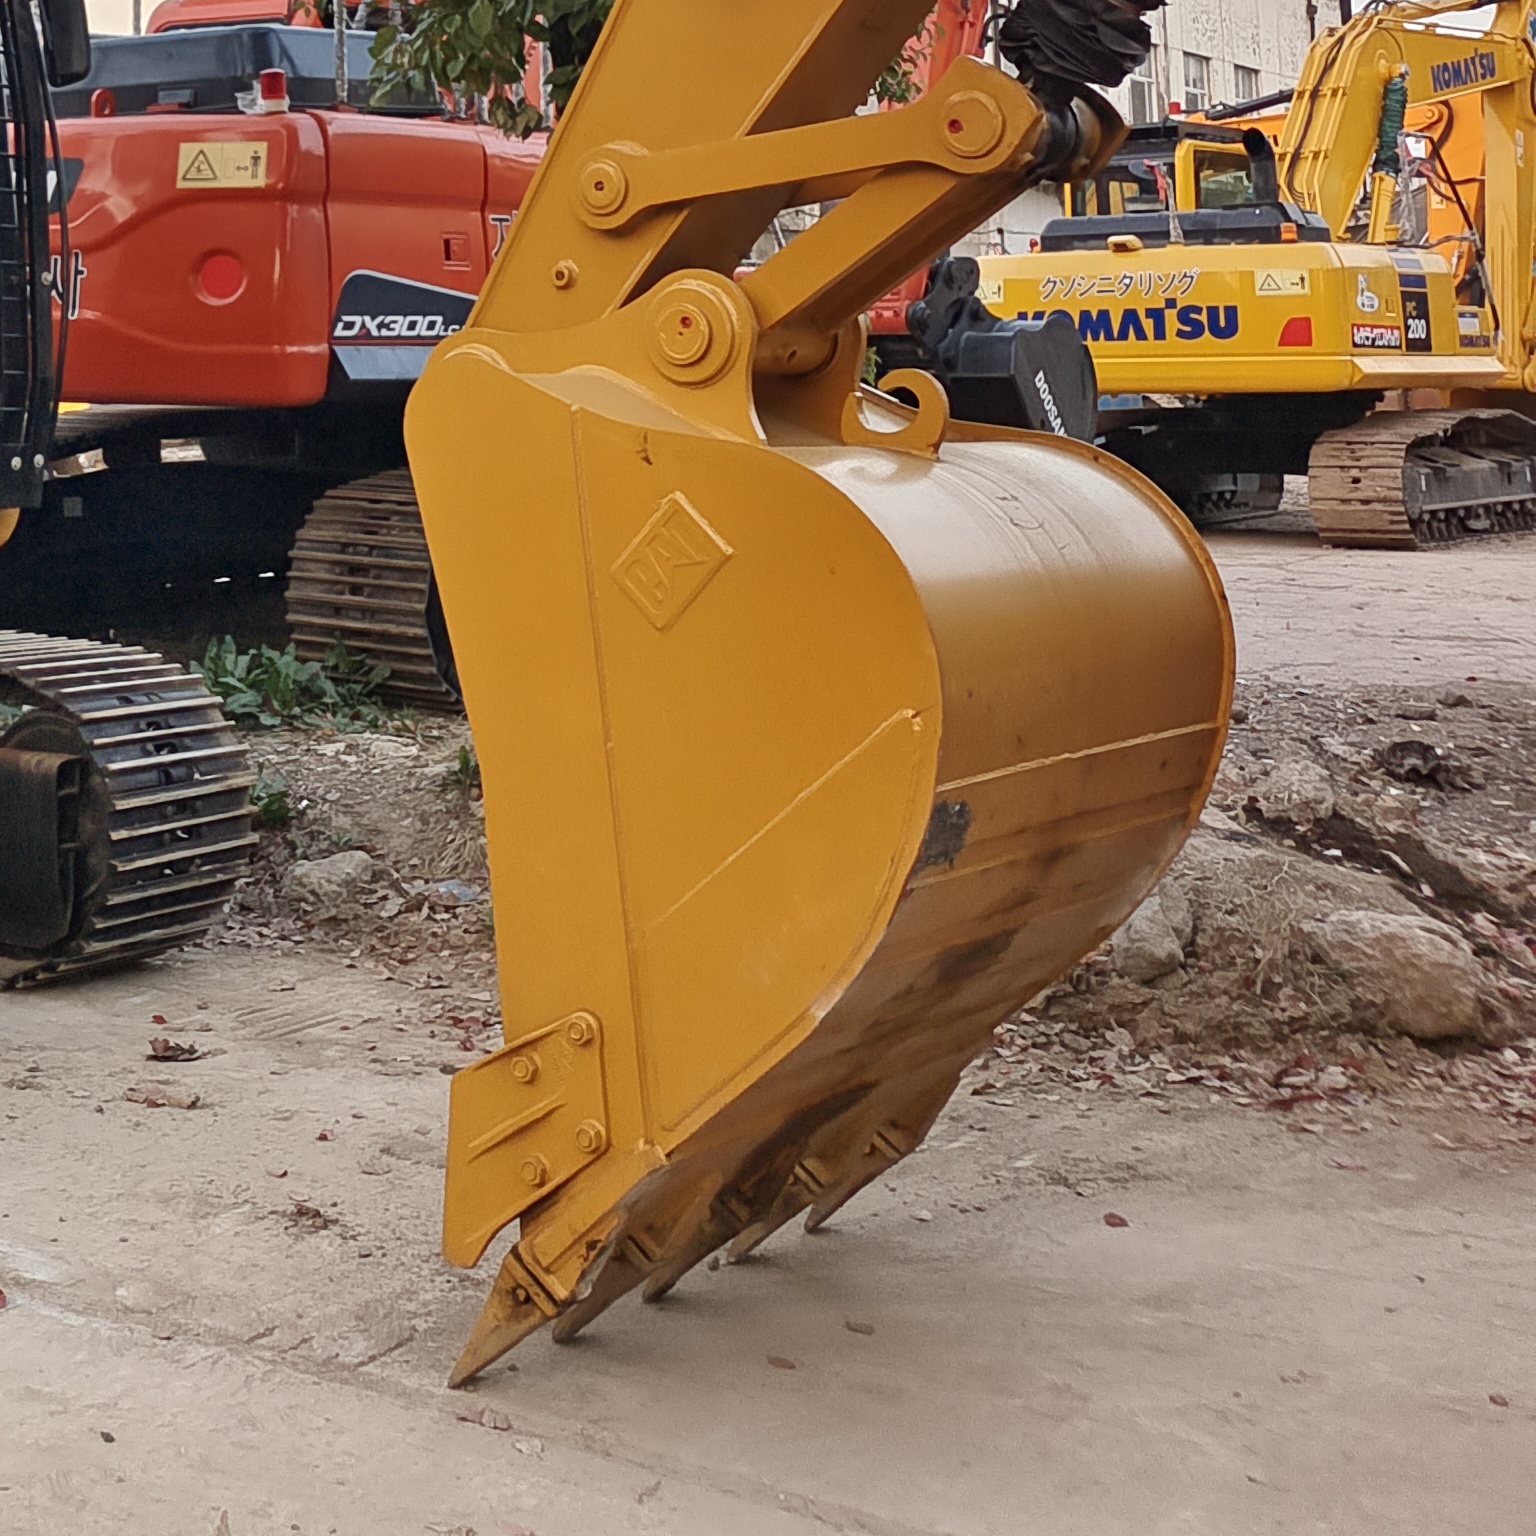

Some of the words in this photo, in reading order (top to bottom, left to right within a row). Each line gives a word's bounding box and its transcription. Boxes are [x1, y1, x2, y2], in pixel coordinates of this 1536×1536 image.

[1430, 48, 1496, 93] KOMATSU
[333, 315, 466, 337] DX300LC
[1407, 318, 1427, 340] 200
